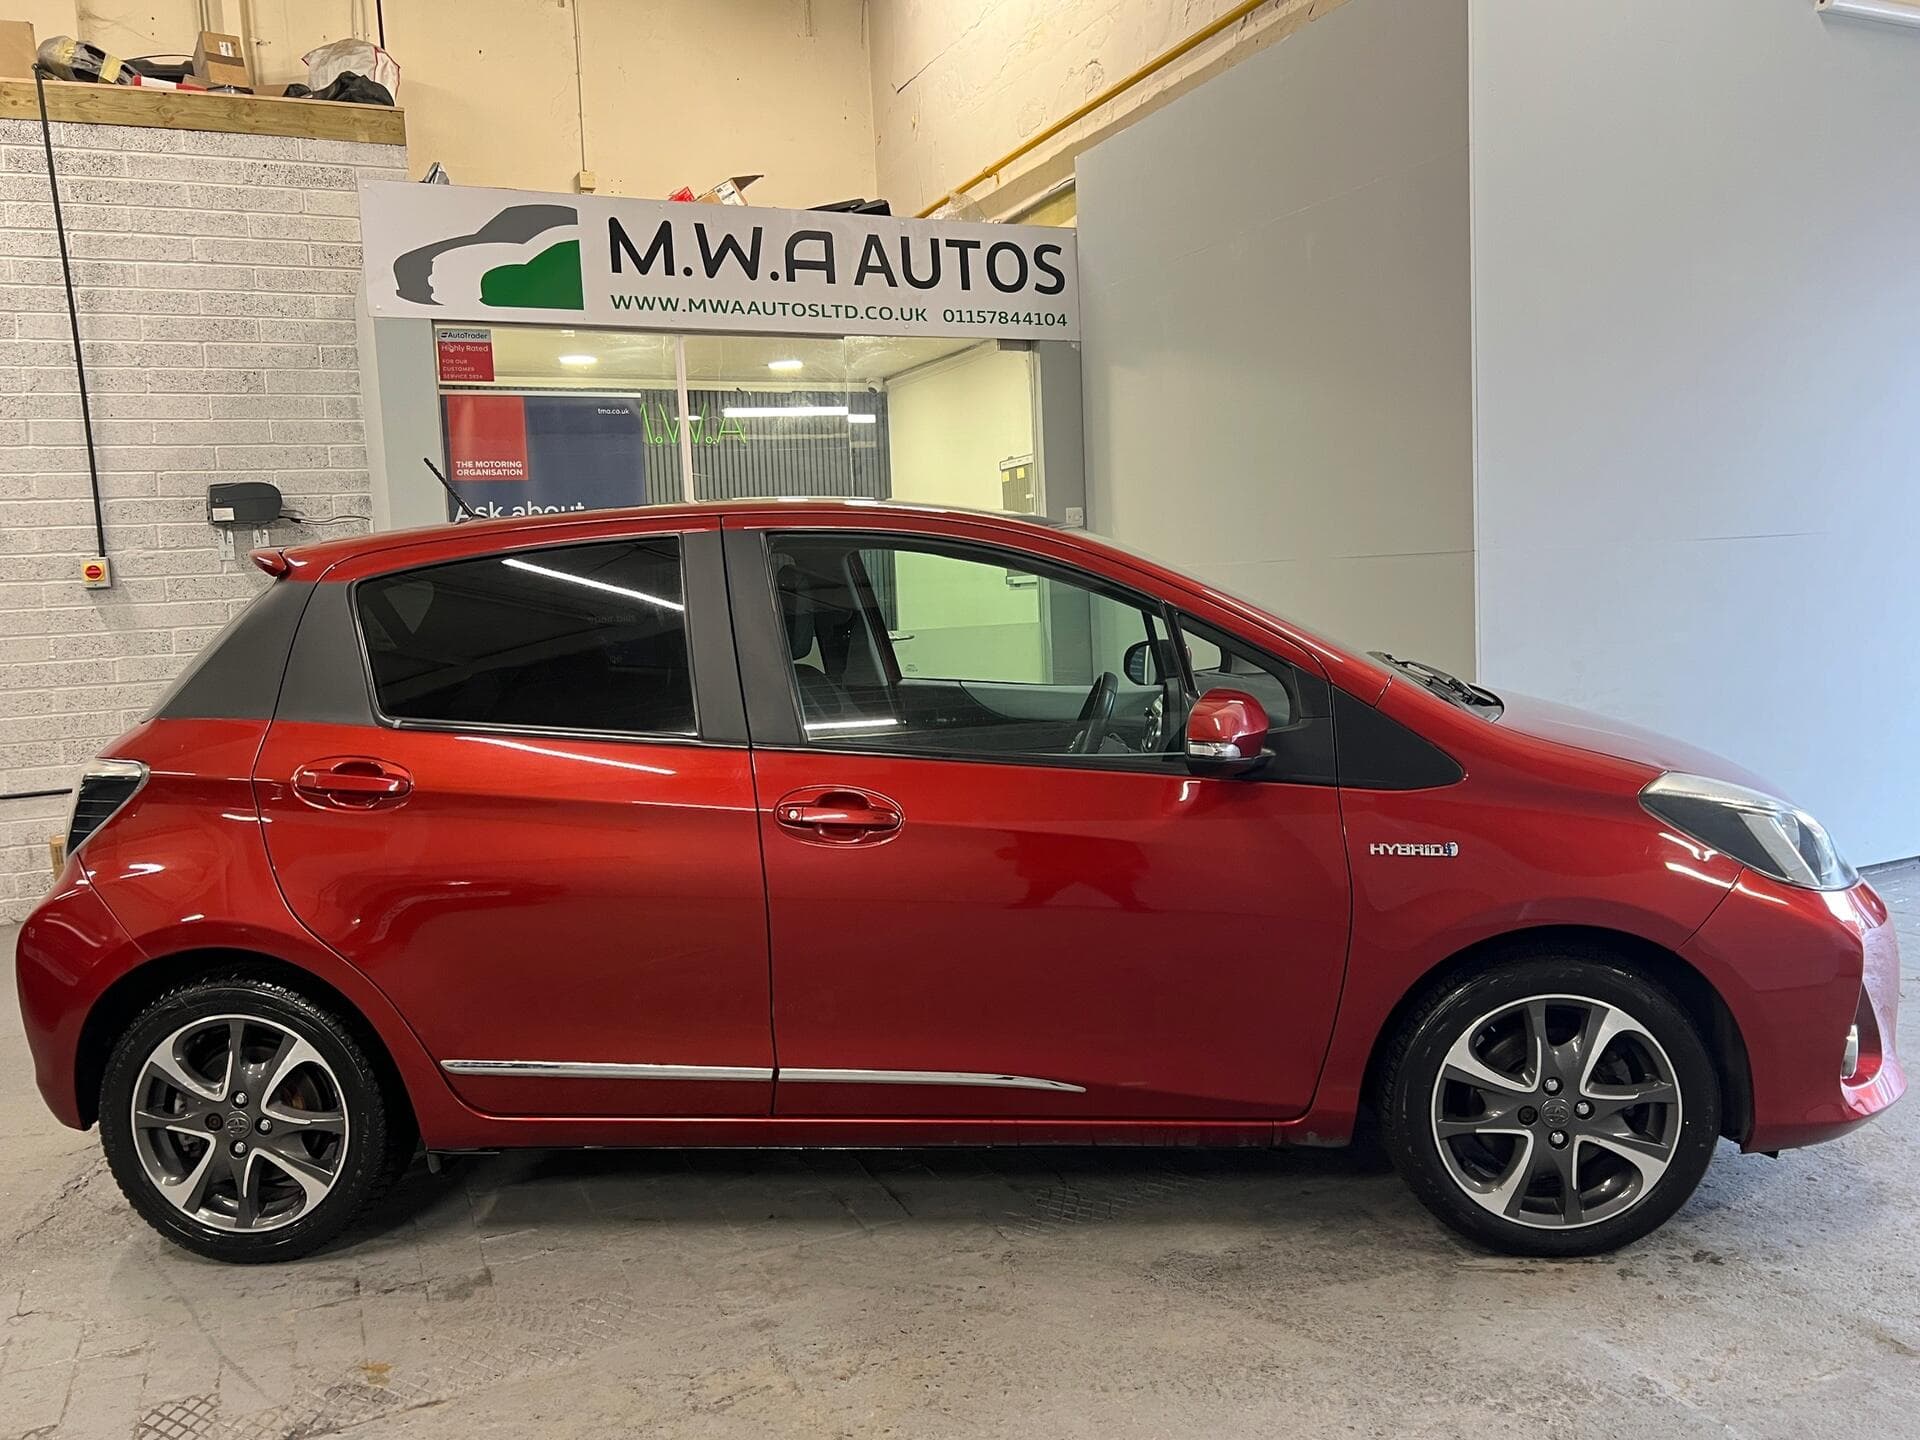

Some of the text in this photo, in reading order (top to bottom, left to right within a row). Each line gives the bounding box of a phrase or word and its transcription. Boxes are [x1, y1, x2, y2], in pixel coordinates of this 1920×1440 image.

[608, 217, 1066, 295] M.W.A AUTOS
[610, 294, 1068, 327] WWW.MWAAUTOSLTD.CO.UK 01157844104
[456, 468, 523, 476] ORGANISATION
[1369, 843, 1442, 856] HYBRID
